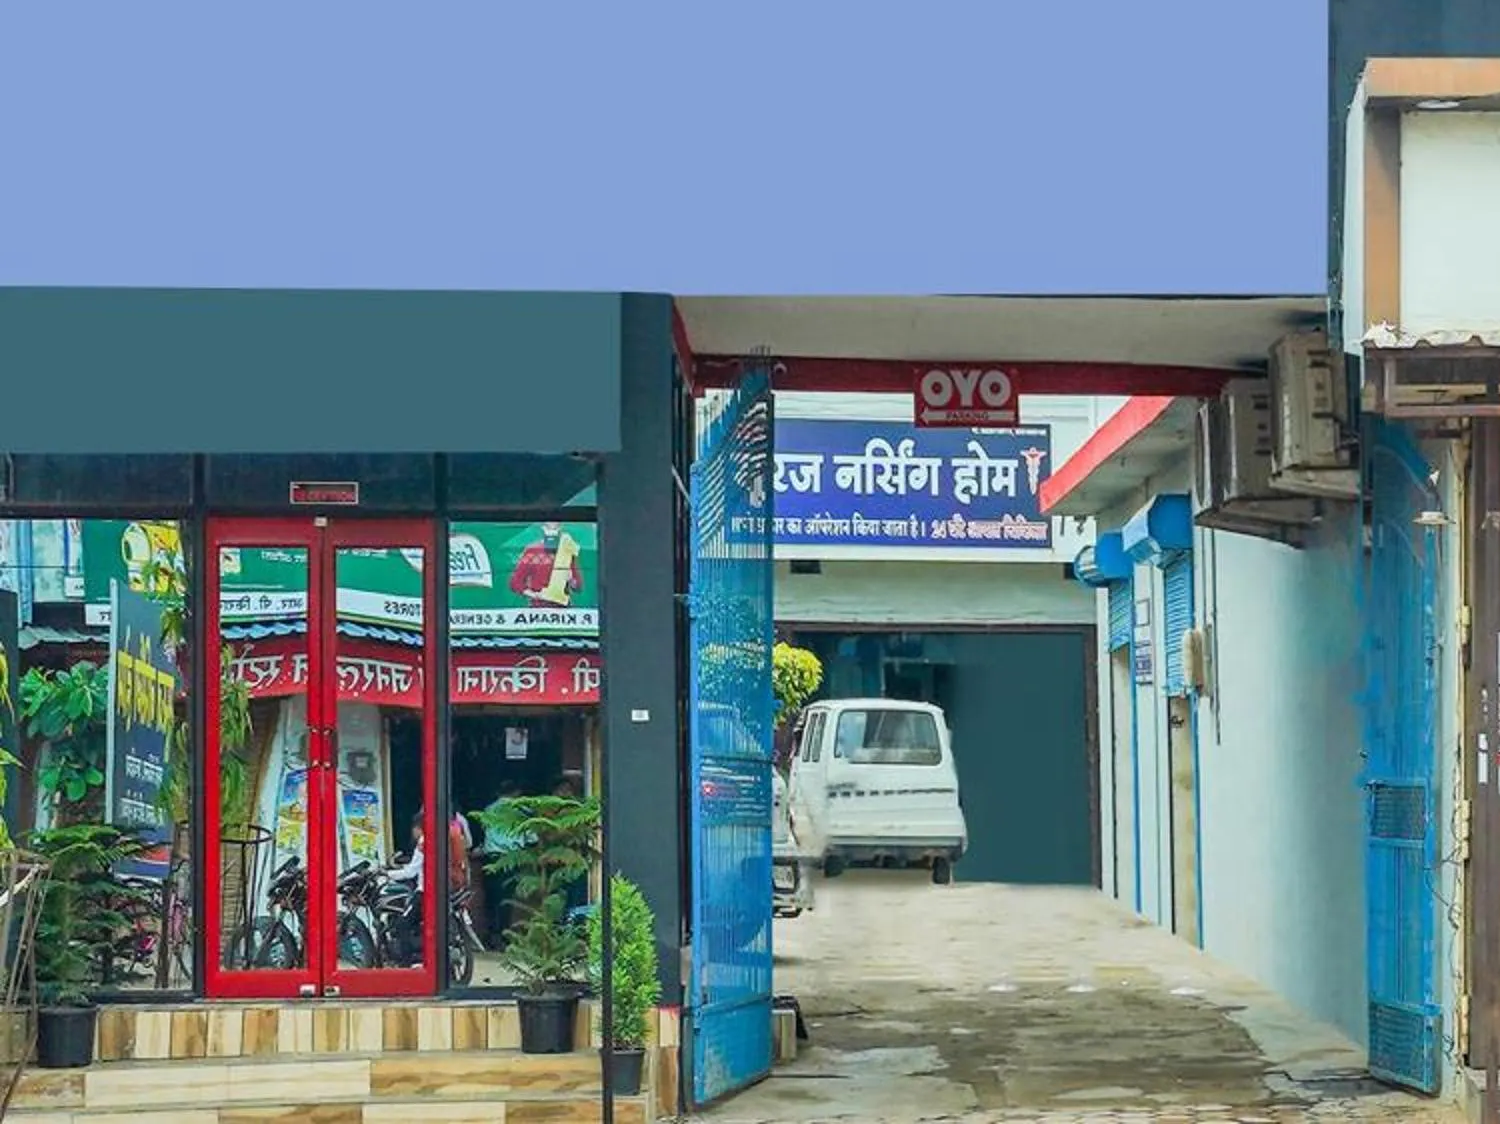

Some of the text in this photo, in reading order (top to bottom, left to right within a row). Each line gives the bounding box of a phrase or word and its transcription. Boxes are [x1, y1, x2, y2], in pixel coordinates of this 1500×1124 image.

[921, 369, 1011, 407] OYO
[832, 437, 942, 496] नर्सिंग
[952, 441, 1018, 505] होम
